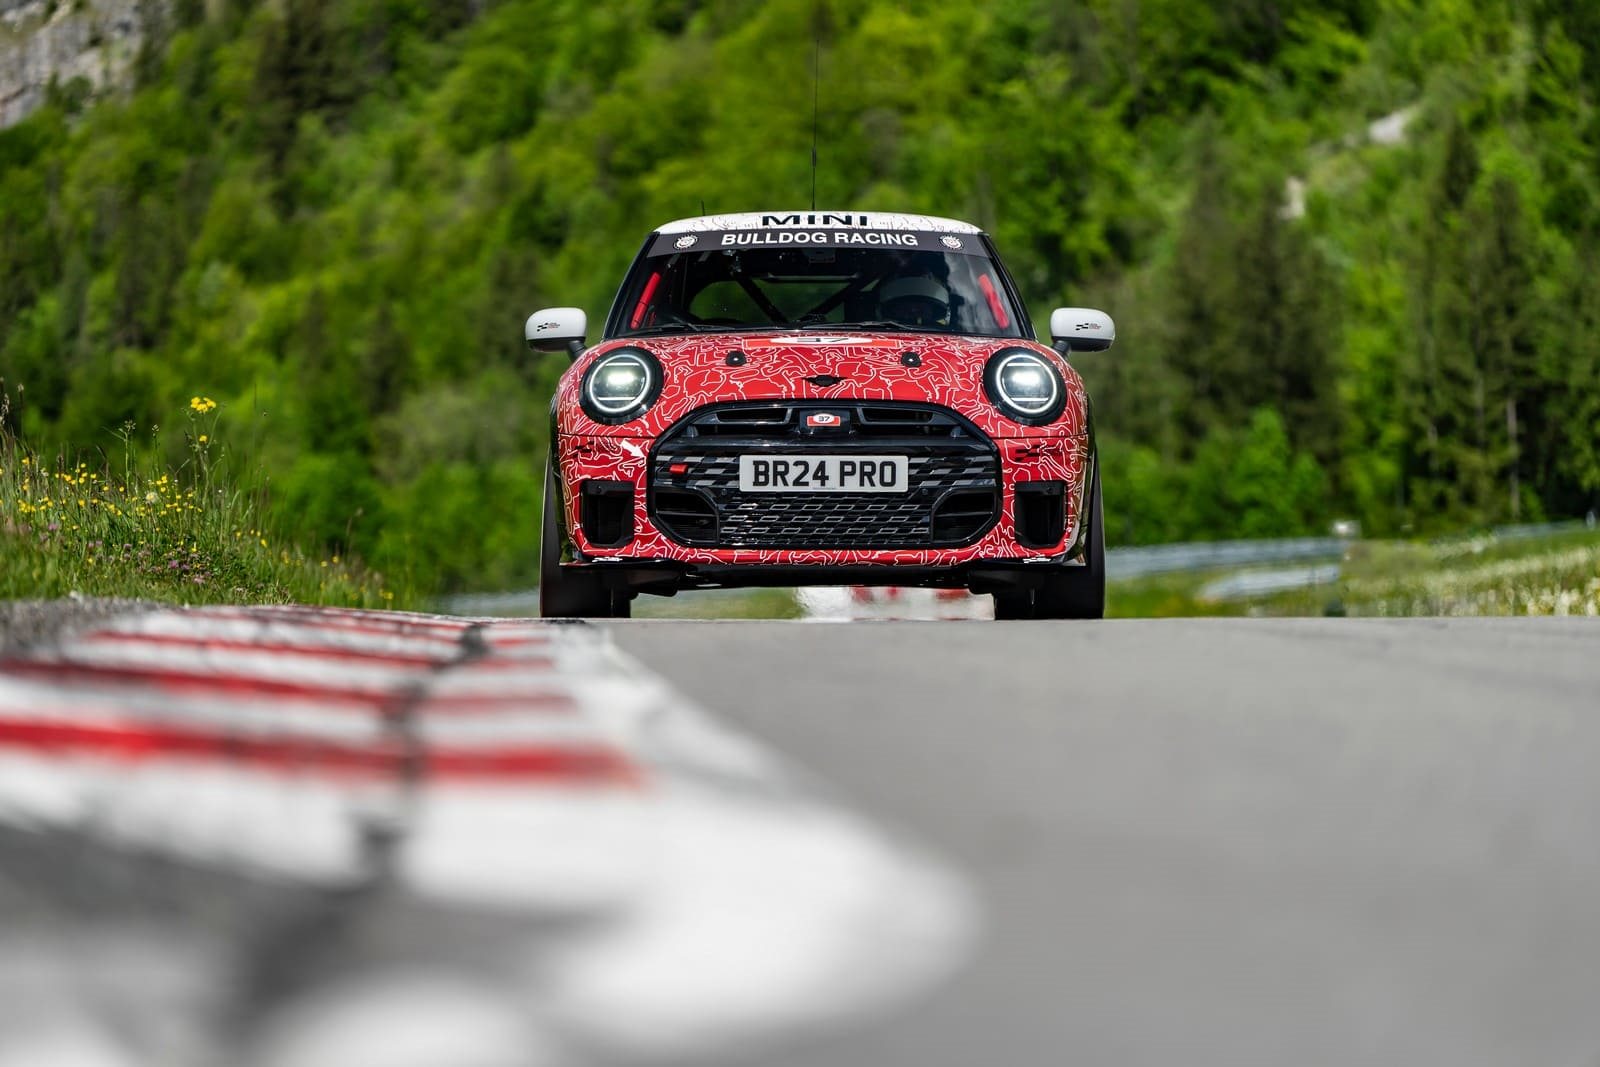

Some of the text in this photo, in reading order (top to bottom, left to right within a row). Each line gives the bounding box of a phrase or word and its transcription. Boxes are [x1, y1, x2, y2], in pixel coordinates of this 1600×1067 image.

[762, 215, 868, 226] MINI
[720, 232, 918, 246] BULLDOG RACING
[752, 460, 896, 487] BR24 PRO
